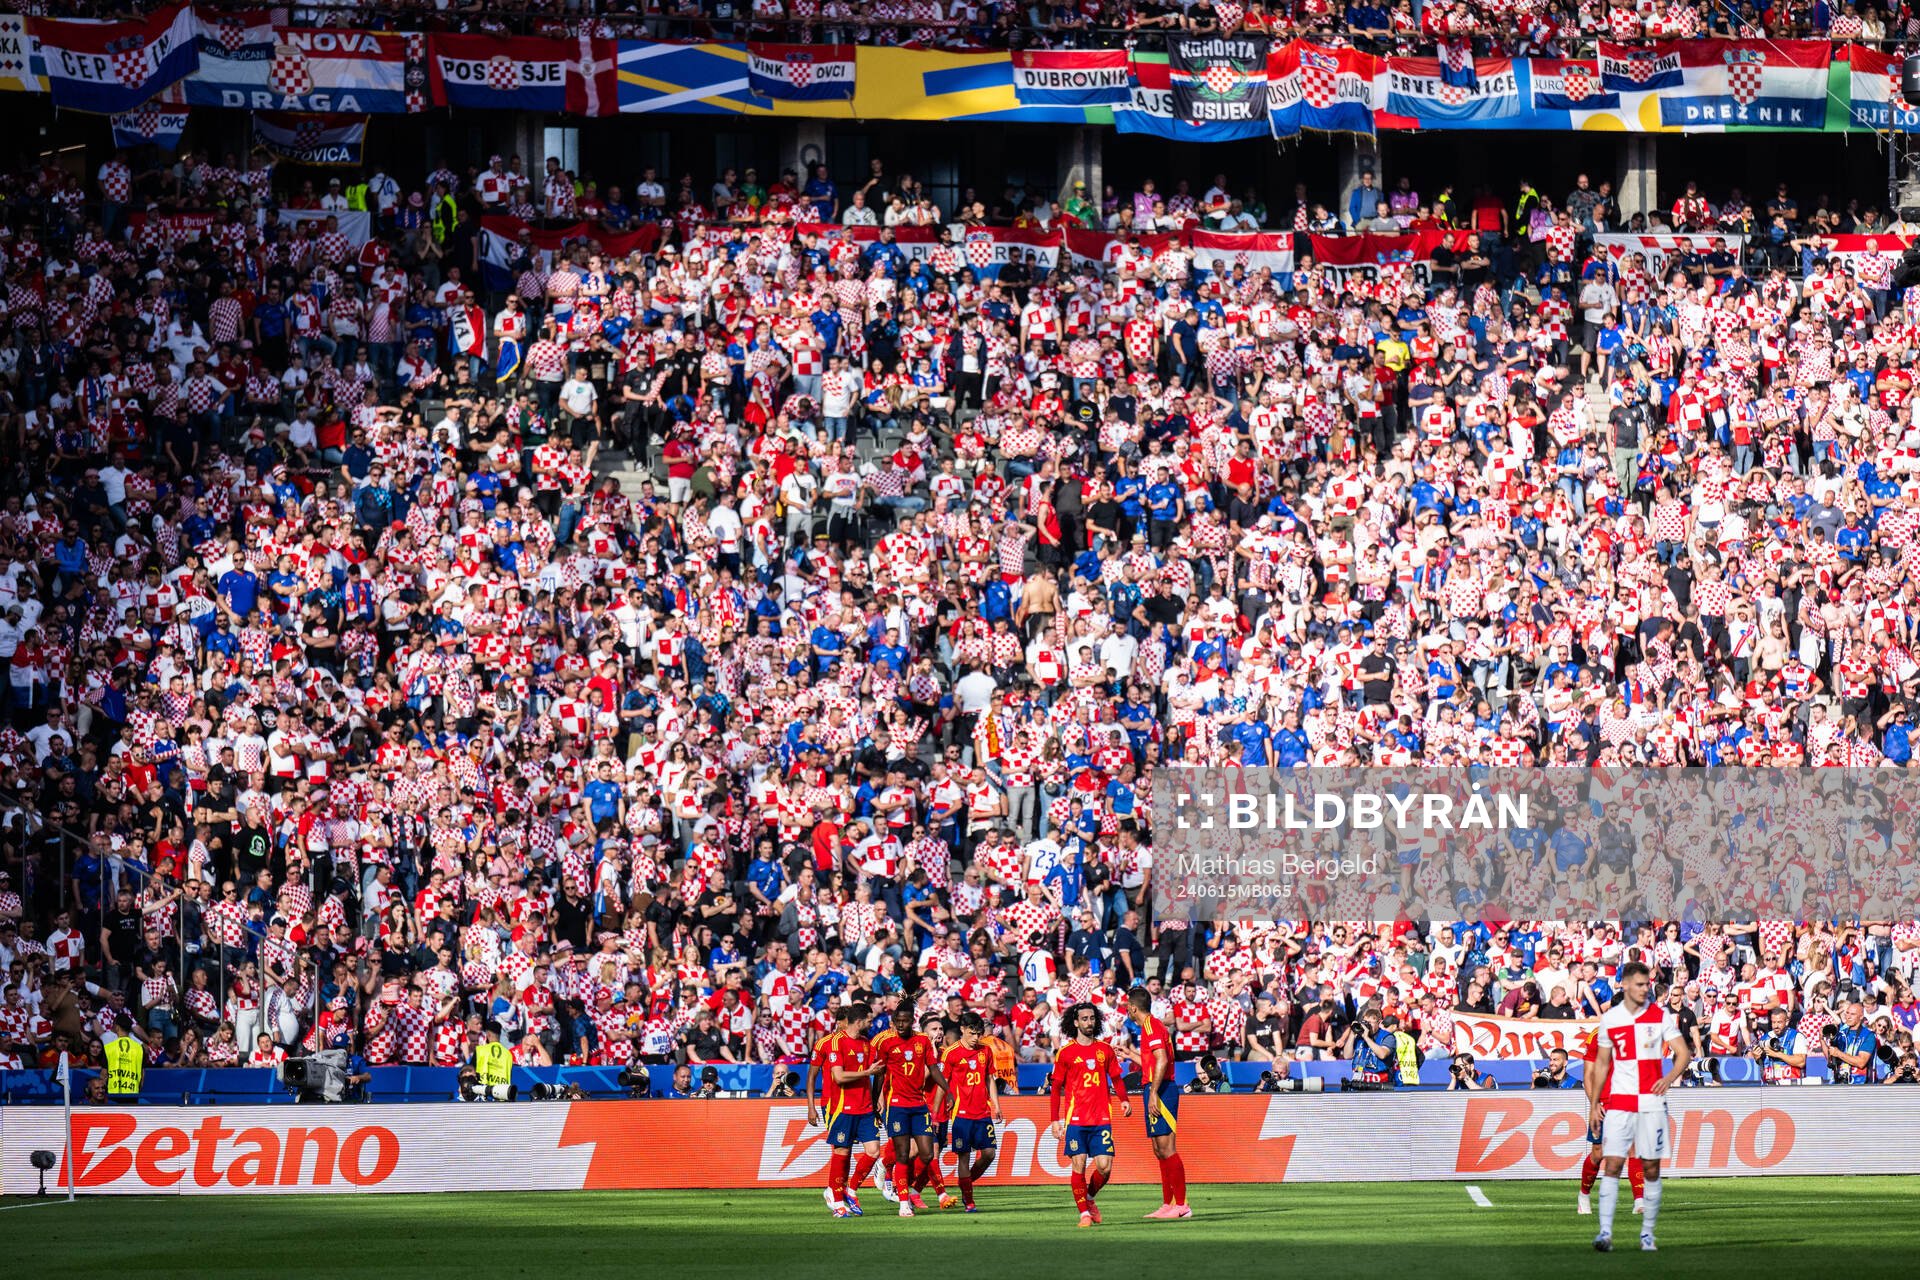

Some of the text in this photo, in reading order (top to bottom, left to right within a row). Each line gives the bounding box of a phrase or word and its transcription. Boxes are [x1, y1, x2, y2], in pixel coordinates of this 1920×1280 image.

[0, 38, 21, 54] KA
[286, 32, 383, 55] NOVA
[1178, 39, 1257, 59] KOHORTA
[443, 61, 486, 81] POS
[521, 59, 562, 81] ŠJE
[752, 56, 845, 79] VINK OVCI
[1604, 60, 1629, 75] RAS
[1024, 69, 1129, 89] DUBROVNIK
[221, 90, 364, 112] DRAGA
[1190, 101, 1254, 119] OSIJEK
[902, 1062, 916, 1076] 17
[966, 1072, 981, 1086] 20
[1084, 1072, 1101, 1088] 24
[1455, 1098, 1796, 1172] Beno
[1656, 1128, 1664, 1146] 2
[57, 1113, 400, 1187] Betano
